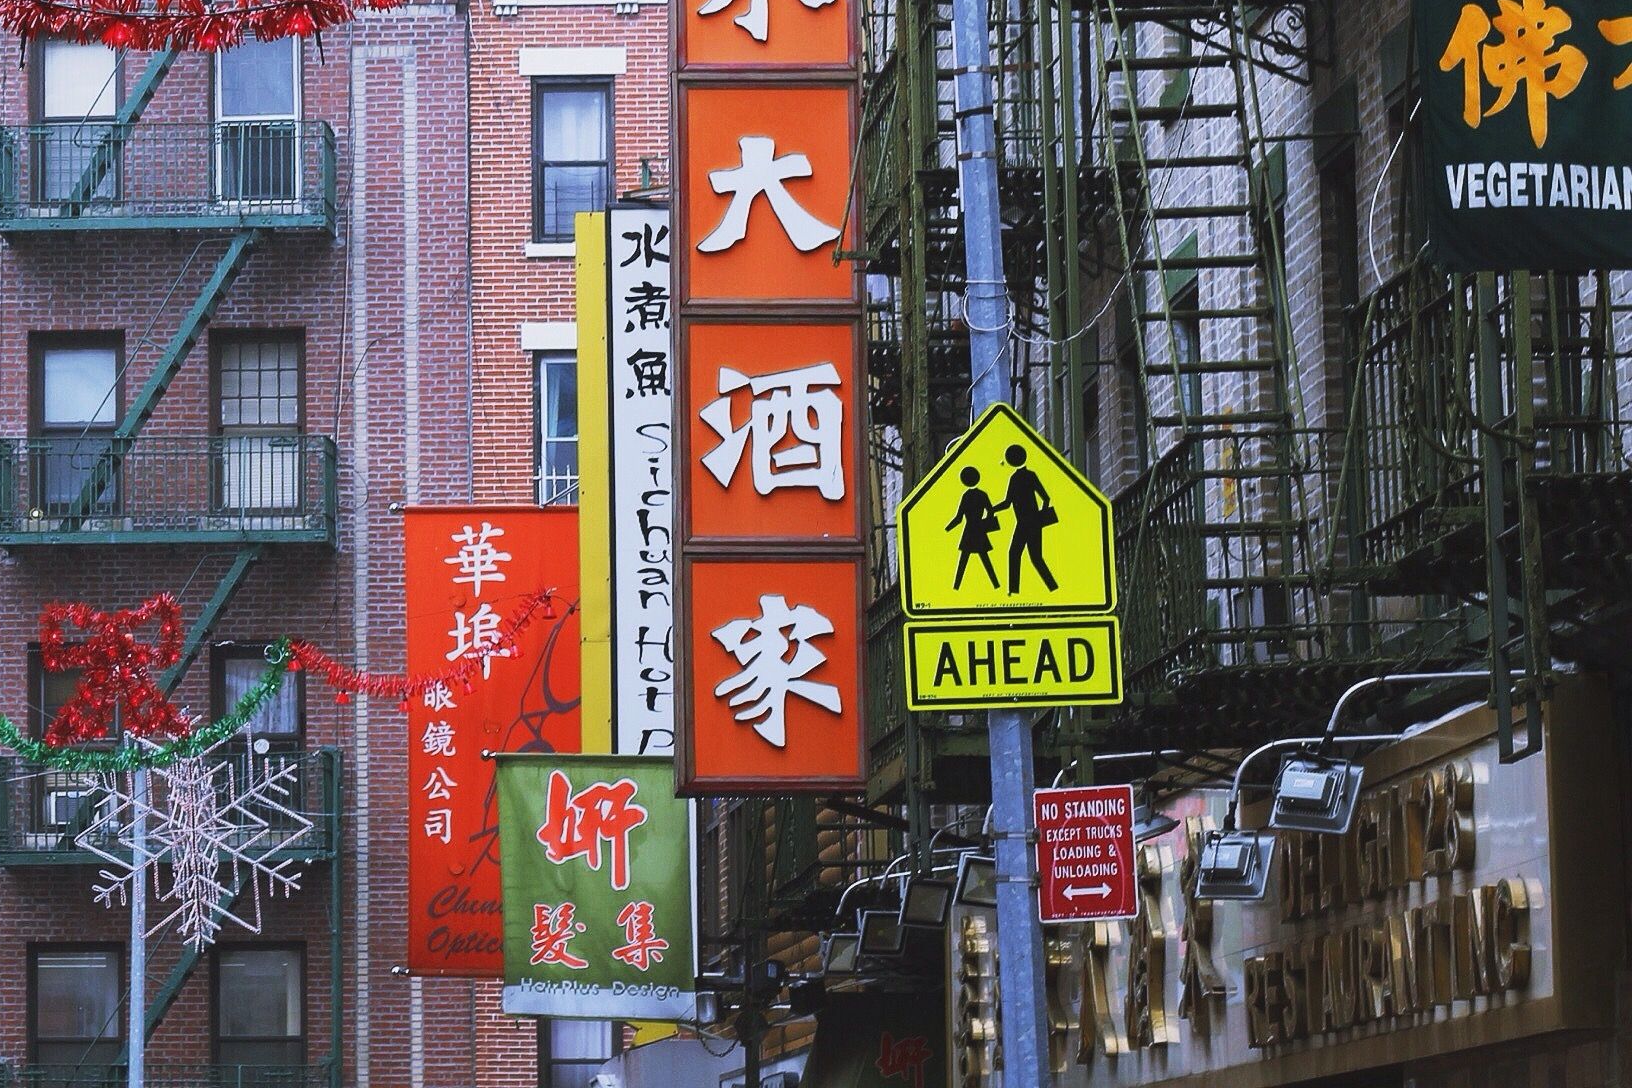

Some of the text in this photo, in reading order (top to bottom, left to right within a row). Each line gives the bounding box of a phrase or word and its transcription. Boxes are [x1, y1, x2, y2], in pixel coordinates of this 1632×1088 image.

[620, 223, 670, 399] 水煮魚
[636, 423, 673, 610] Sichuan
[444, 521, 512, 681] 華埠
[933, 637, 1095, 687] AHEAD
[421, 682, 459, 845] 眼鏡公司
[1041, 798, 1126, 820] NO STANDING
[1046, 825, 1123, 843] EXCEPT TRUCKS
[1423, 758, 1475, 877] 28
[1053, 844, 1117, 861] LOADING &
[1054, 863, 1118, 879] UNLOADING
[530, 901, 669, 972] 髮集
[612, 981, 680, 1001] Design
